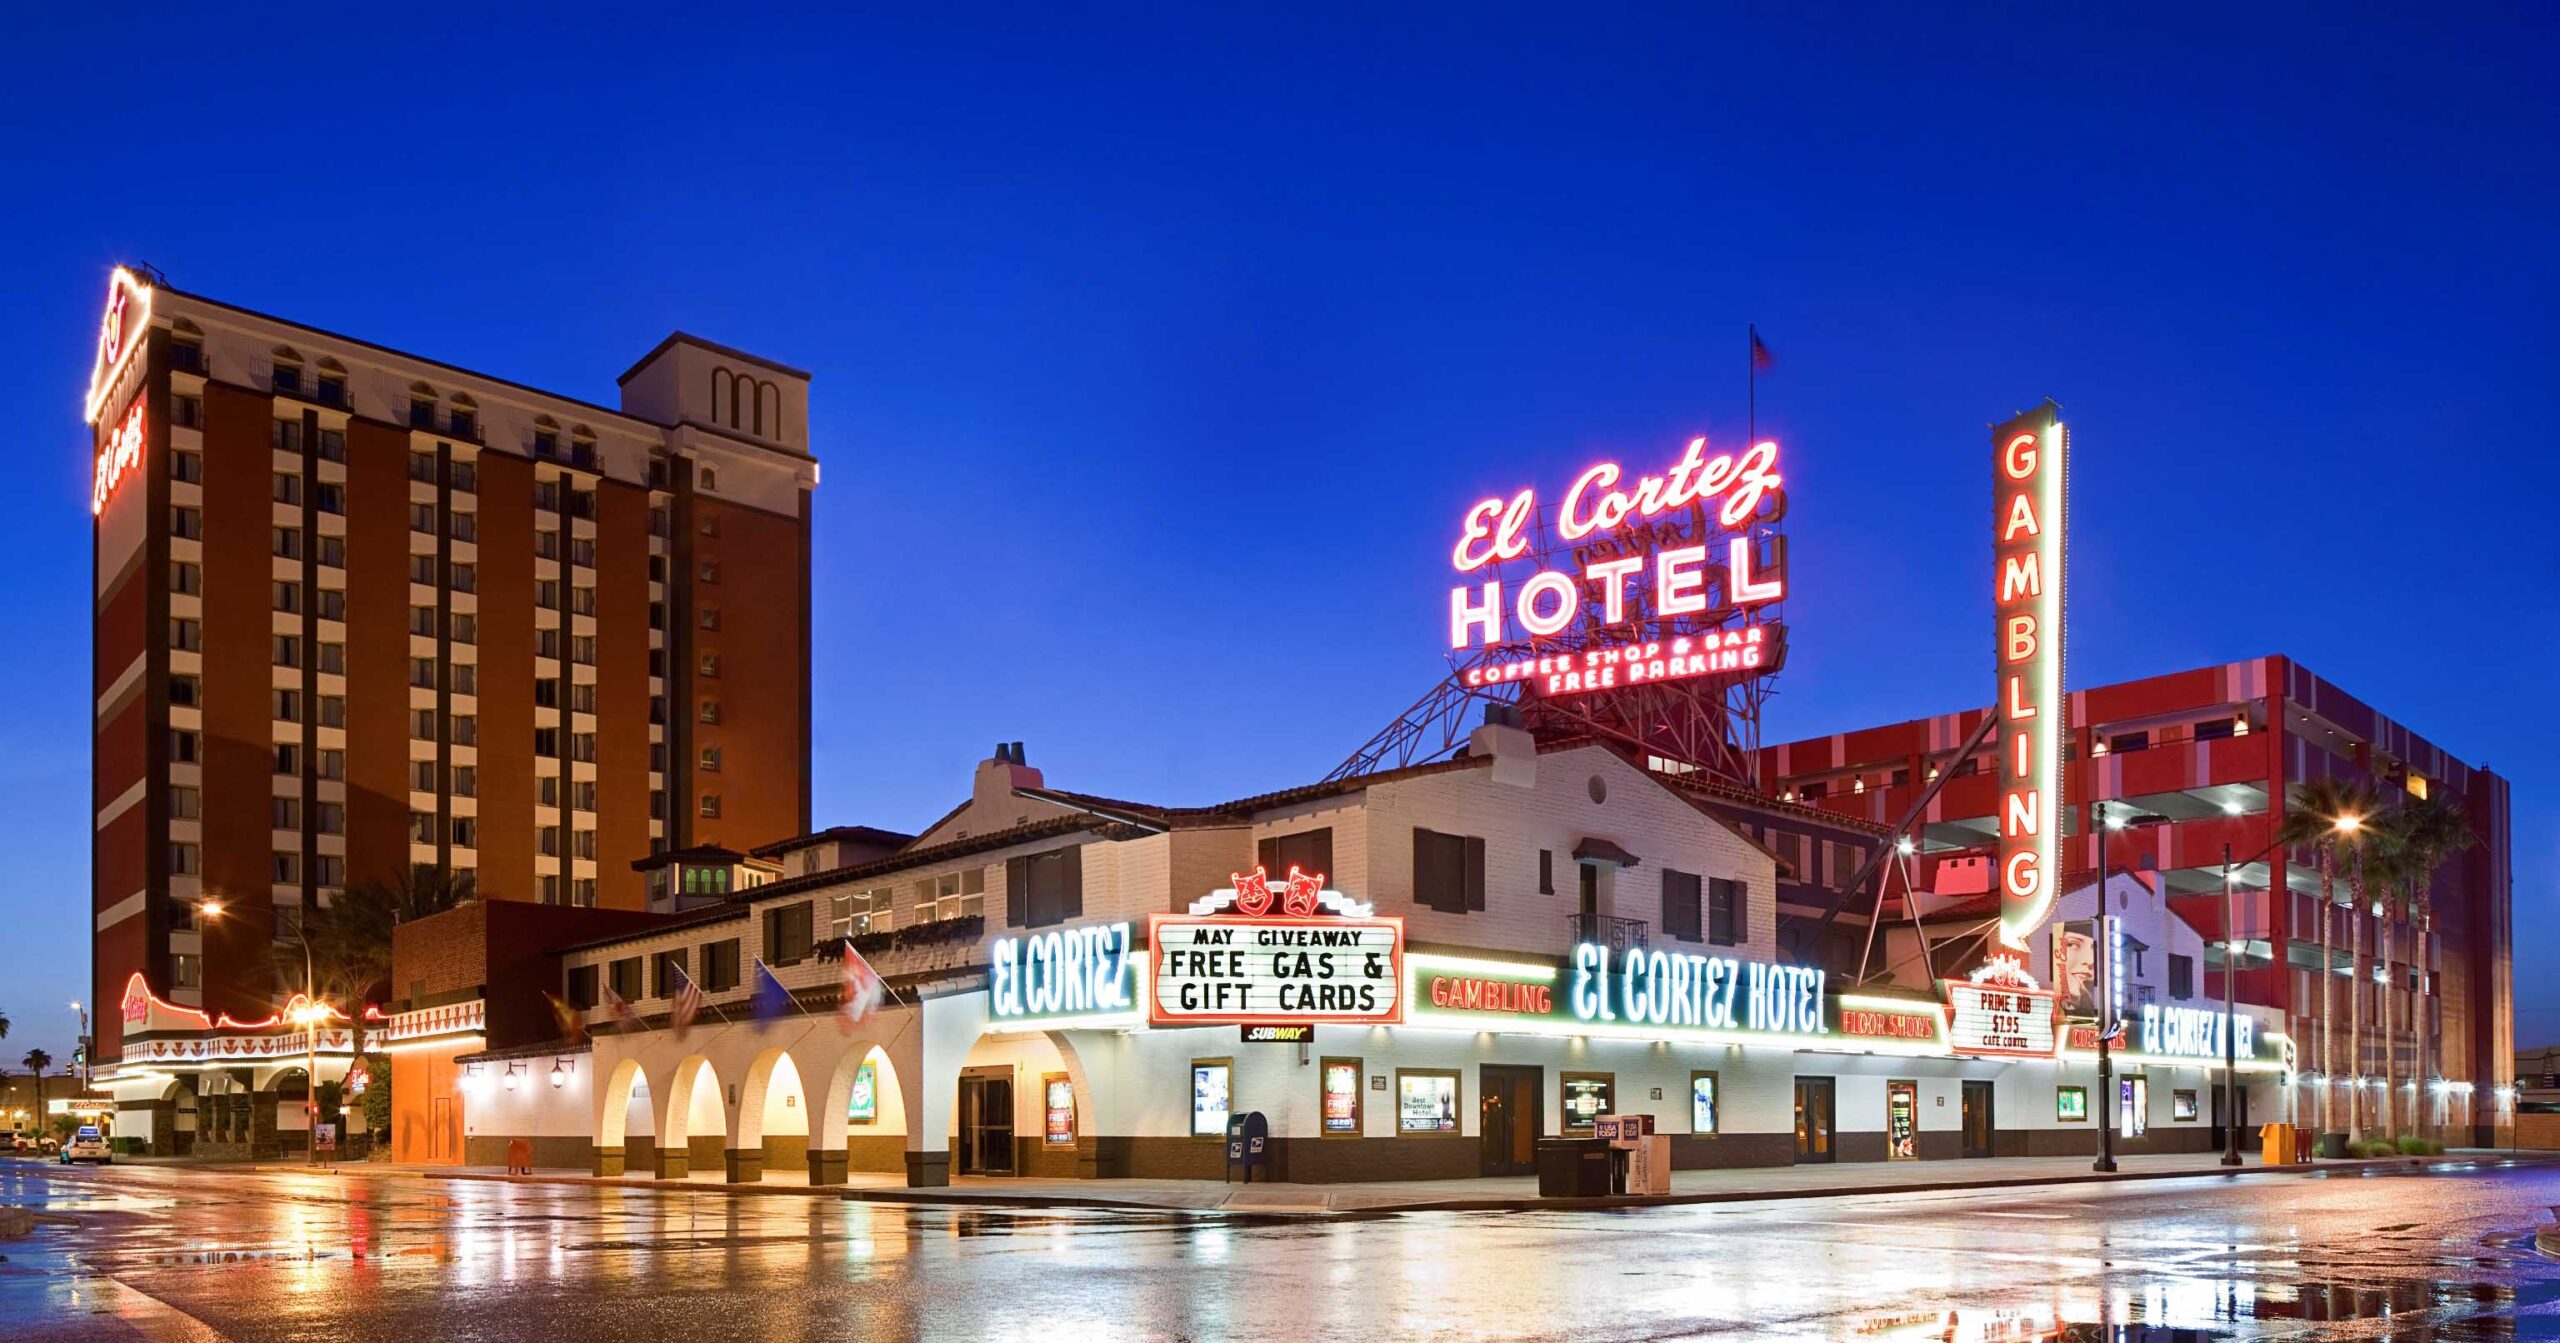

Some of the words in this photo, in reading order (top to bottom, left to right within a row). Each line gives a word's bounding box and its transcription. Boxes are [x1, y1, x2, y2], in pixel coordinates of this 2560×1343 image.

[1453, 489, 1535, 572] El
[1559, 436, 1782, 541] Cortez
[1452, 536, 1782, 649] HOTEL
[1467, 654, 1571, 685] COFFEE
[1586, 644, 1660, 667] SHOP
[1671, 637, 1691, 655] &
[1705, 627, 1762, 651] BAR
[1549, 667, 1615, 694] FREE
[1629, 645, 1760, 683] PARKING
[2002, 433, 2042, 898] GAMBLING
[1192, 928, 1234, 945] MAY
[1257, 930, 1363, 946] GIVEAWAY
[993, 937, 1024, 1016] EL
[1025, 921, 1131, 1014] CORTEZ
[1170, 950, 1246, 978] FREE
[1272, 951, 1335, 980] GAS
[1363, 952, 1383, 980] &
[1180, 982, 1252, 1011] GIFT
[1279, 984, 1376, 1011] CARDS
[1431, 976, 1552, 1014] GAMBLING
[1574, 942, 1616, 1021] EL
[1624, 948, 1739, 1029] CORTEZ
[1748, 961, 1829, 1035] HOTEL
[1980, 992, 2011, 1012] PRIME
[2016, 995, 2031, 1014] RIB
[1247, 1026, 1308, 1041] SUBWAY
[1842, 1010, 1886, 1035] FLOOR
[1888, 1014, 1933, 1038] SHOWS
[2143, 1003, 2163, 1054] EL
[2163, 1005, 2215, 1057] CORTEZ
[2216, 1012, 2256, 1060] HTEL
[1983, 1035, 2001, 1047] CAFE
[2003, 1037, 2029, 1049] CORTEZ
[1403, 1102, 1436, 1110] Downtown
[1411, 1096, 1426, 1104] Best
[1598, 1129, 1618, 1137] TODAY
[1628, 1122, 1638, 1130] USA
